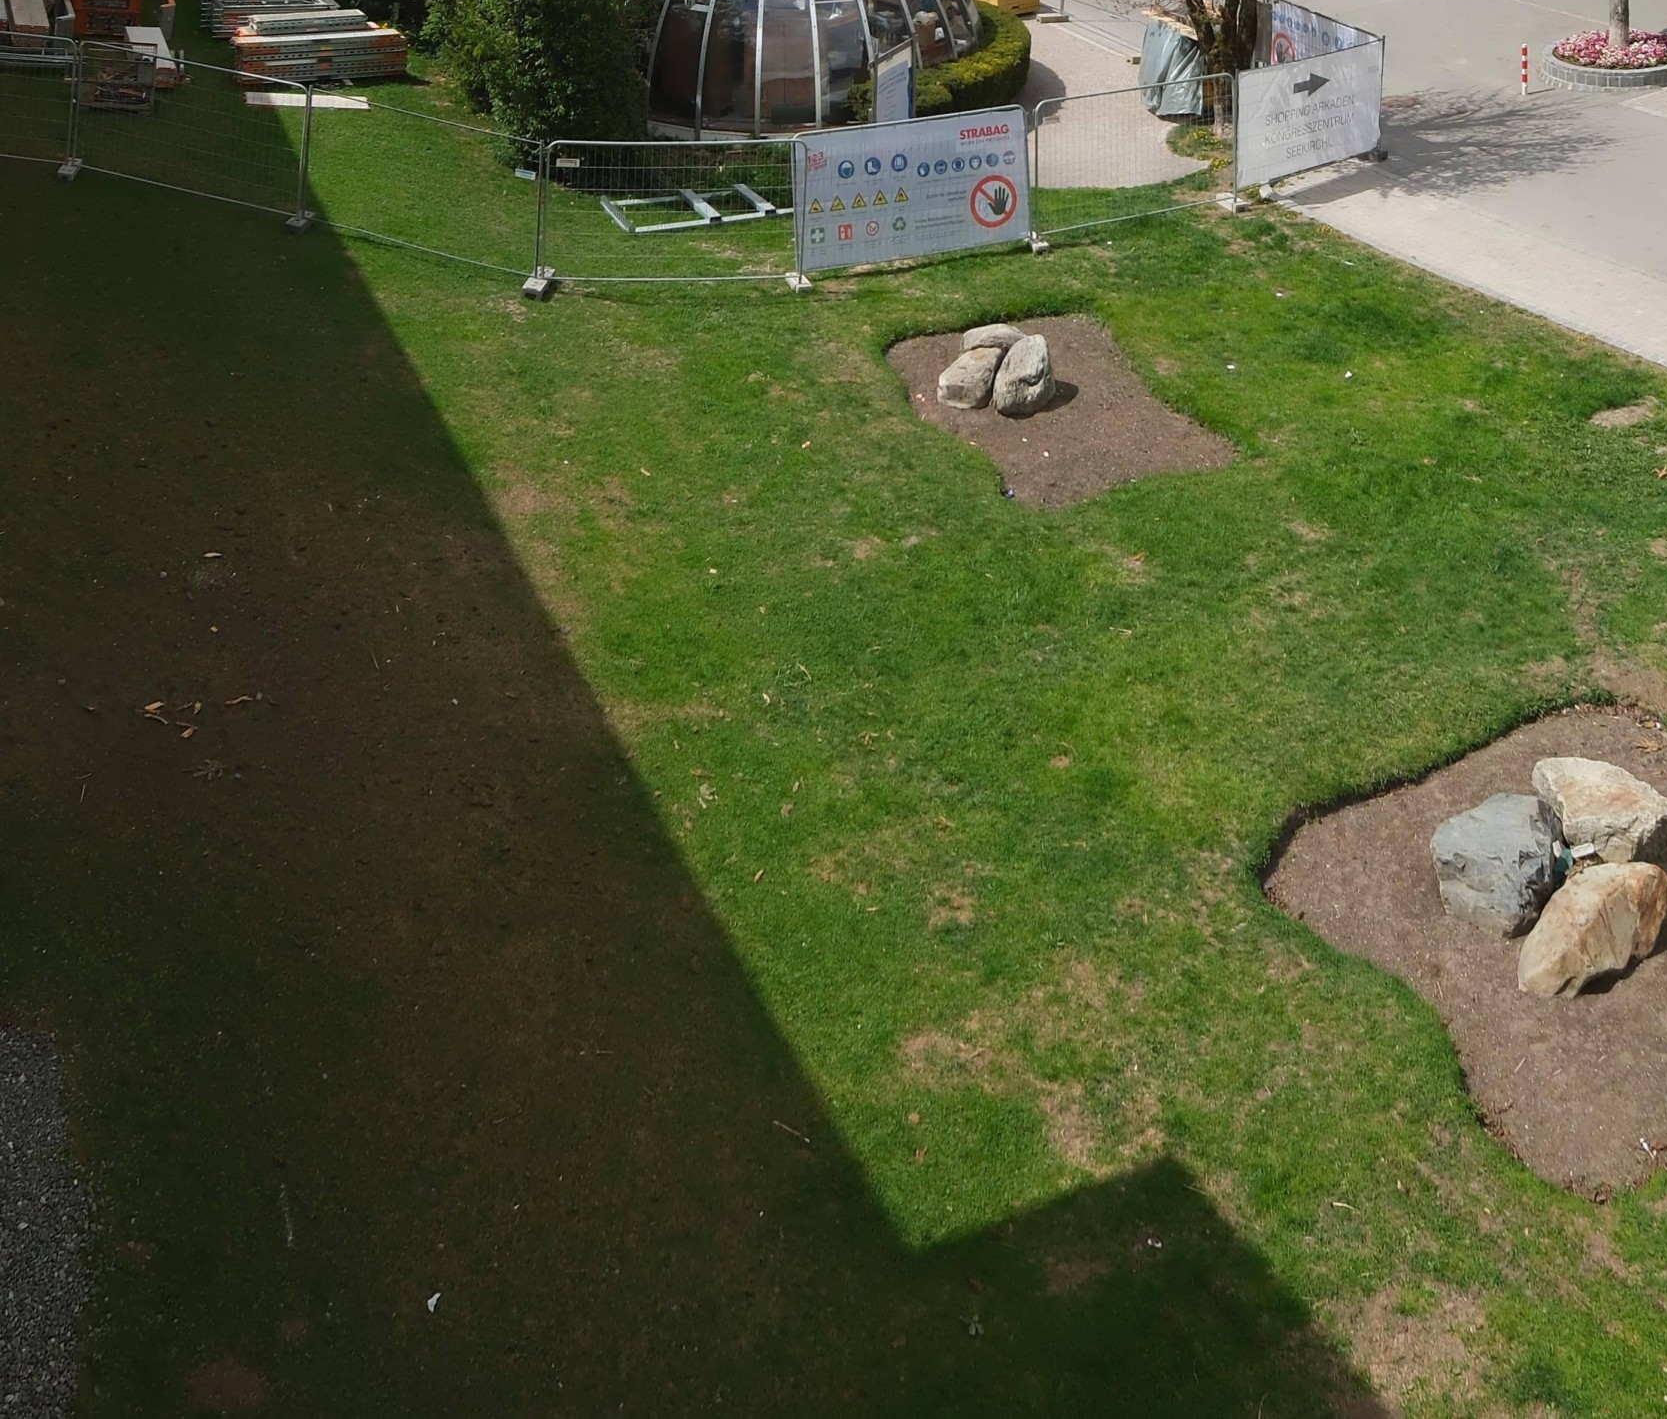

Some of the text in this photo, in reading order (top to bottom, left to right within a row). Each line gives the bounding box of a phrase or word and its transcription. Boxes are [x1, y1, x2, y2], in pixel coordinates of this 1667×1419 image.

[1265, 94, 1355, 126] SHOPPING ARKADEN
[960, 124, 1009, 140] STRABAG
[1264, 113, 1354, 146] KONGRESSZENTRUM
[1286, 138, 1334, 159] SEEKIRCHL
